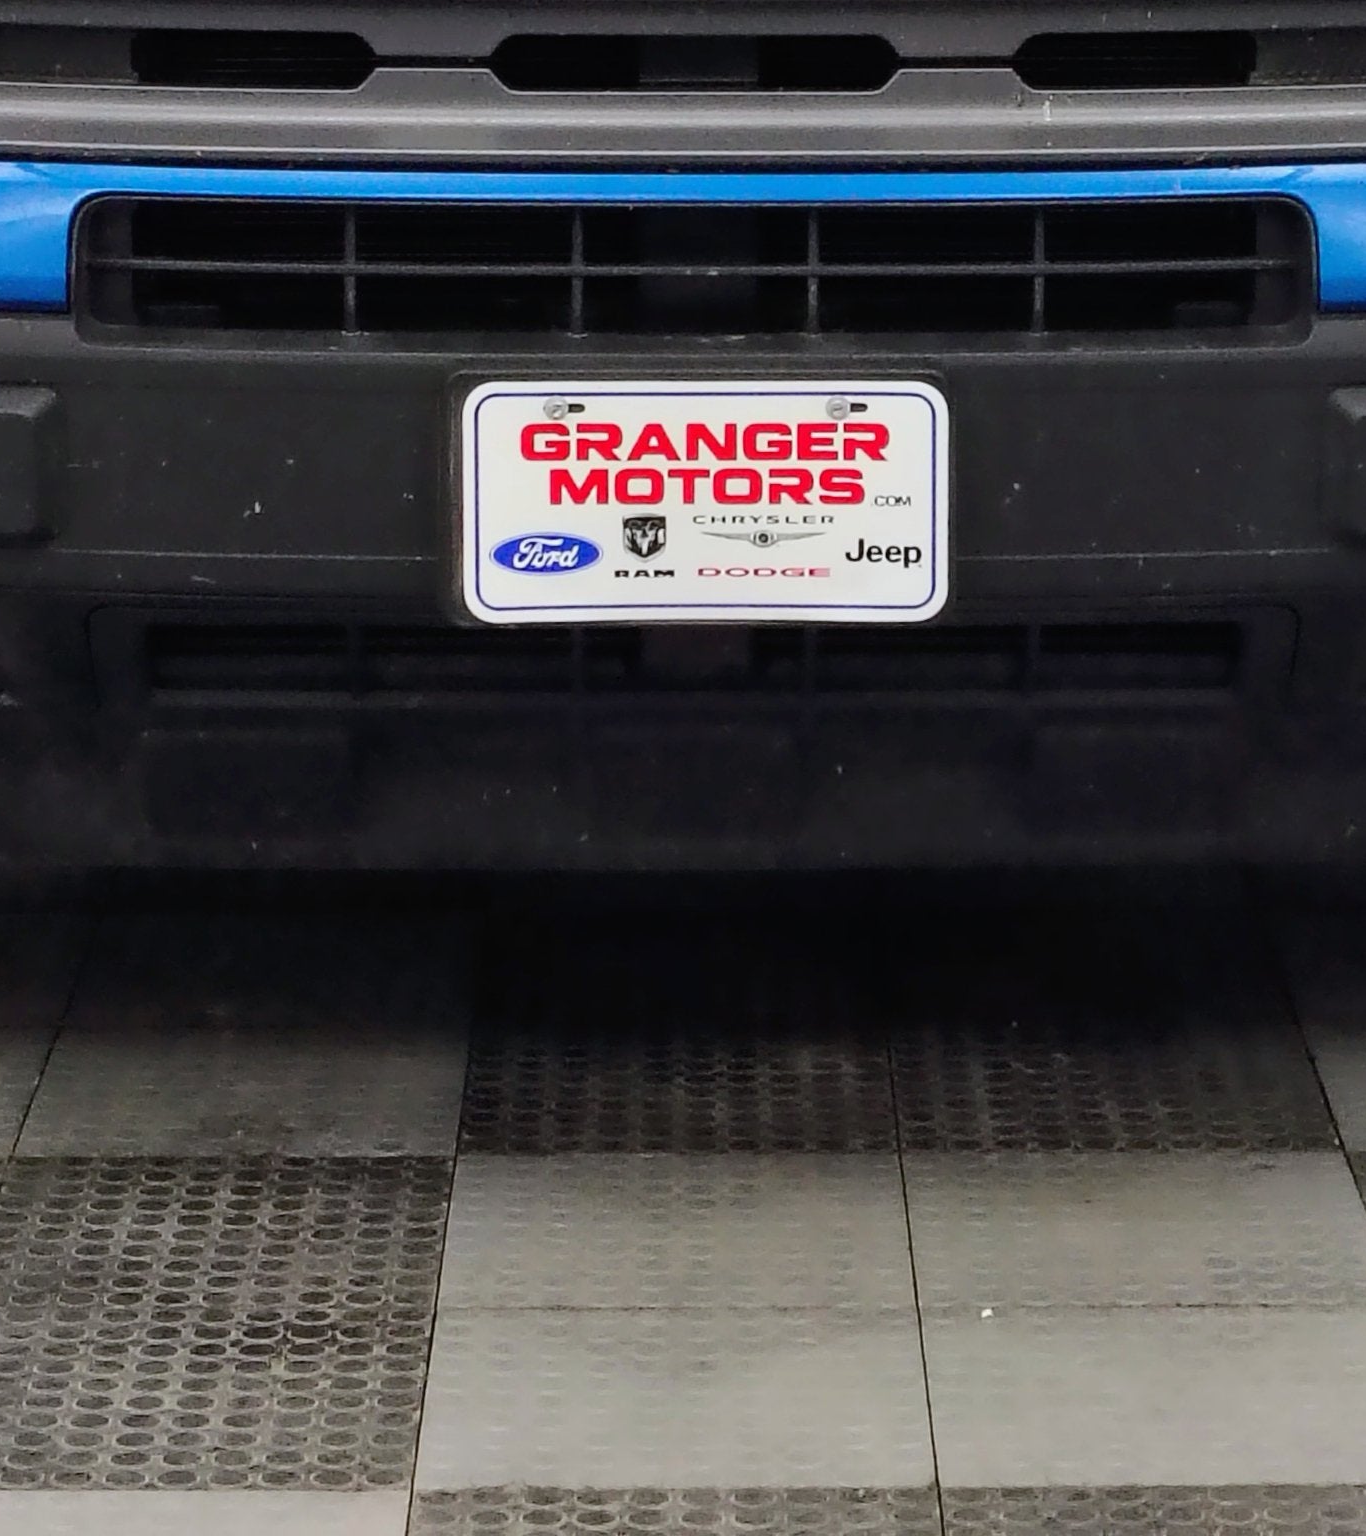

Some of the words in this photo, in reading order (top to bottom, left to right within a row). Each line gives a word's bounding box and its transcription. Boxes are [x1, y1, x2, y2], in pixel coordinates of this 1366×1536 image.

[520, 423, 889, 461] GRANGER
[549, 468, 864, 505] MOTORS
[871, 495, 912, 507] .COM
[693, 514, 835, 525] CHRYSLER
[513, 537, 580, 569] Ford
[845, 538, 922, 568] Jeep
[614, 569, 675, 578] RAM
[698, 568, 831, 577] DODGE
